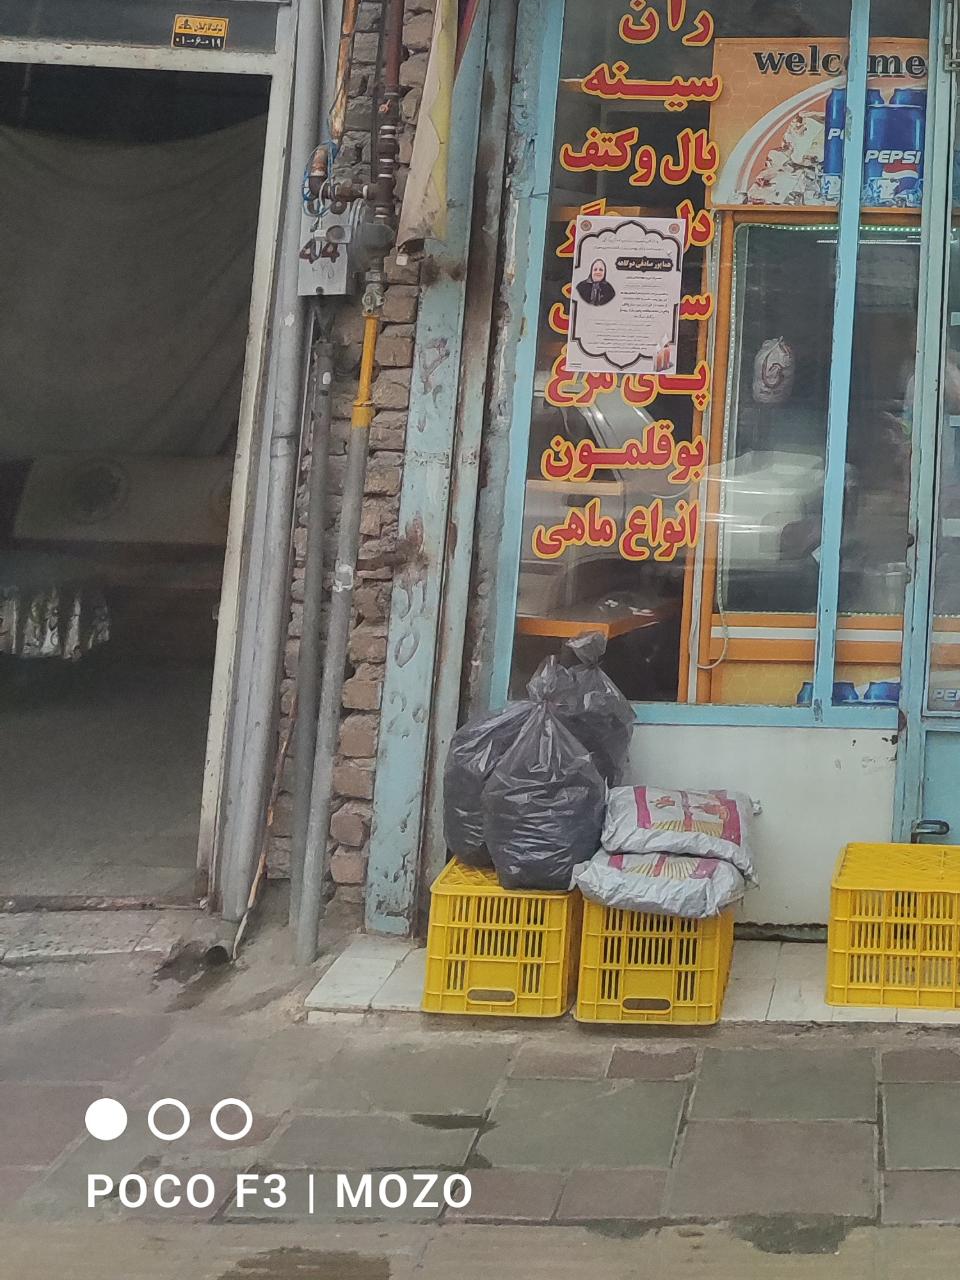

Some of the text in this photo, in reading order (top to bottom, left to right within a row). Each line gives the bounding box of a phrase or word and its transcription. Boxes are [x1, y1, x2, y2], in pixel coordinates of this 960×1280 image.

[582, 61, 722, 112] سینه
[753, 44, 927, 78] welcme
[560, 127, 720, 187] بال و کتف
[864, 150, 922, 164] PEPSI
[541, 420, 705, 482] بوقلمون
[532, 498, 699, 561] انواع ماهی
